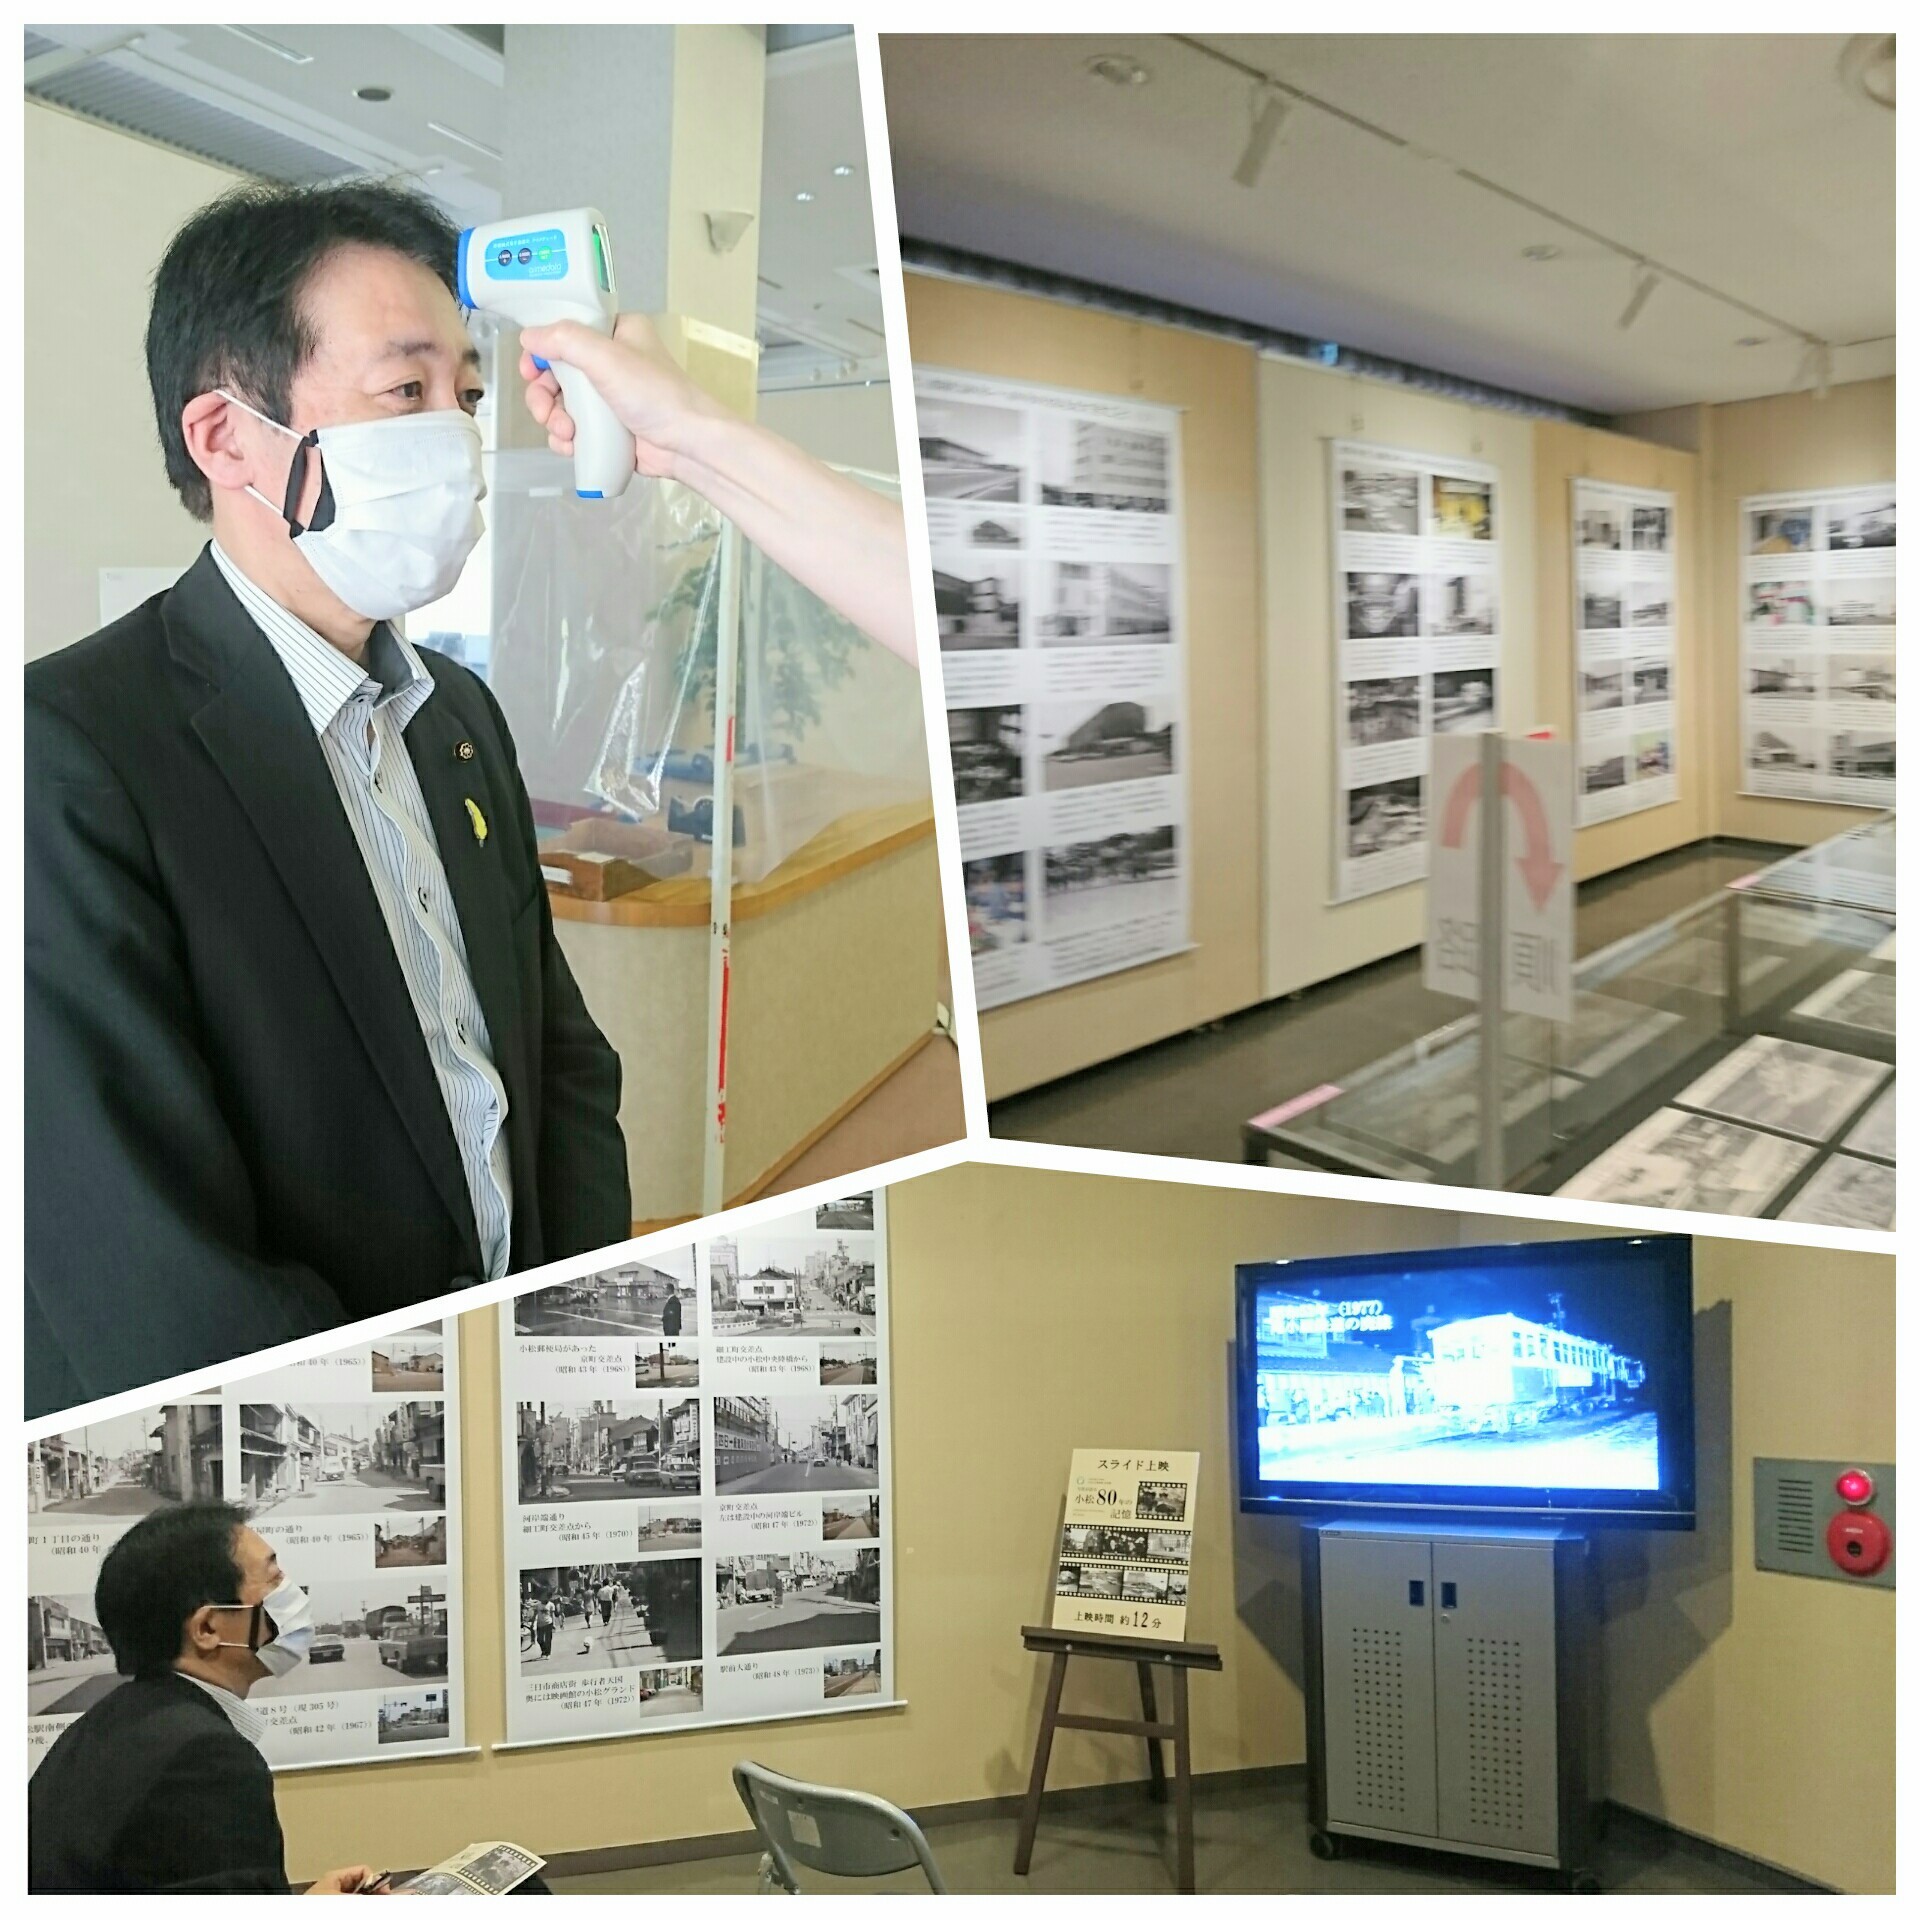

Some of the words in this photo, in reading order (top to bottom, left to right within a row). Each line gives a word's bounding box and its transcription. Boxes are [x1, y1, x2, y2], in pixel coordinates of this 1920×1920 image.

[519, 1344, 597, 1353] 小松郵便局があった
[1097, 1459, 1170, 1472] スライド上映
[1110, 1508, 1132, 1519] 記憶
[1074, 1610, 1115, 1625] 上映時間
[1119, 1611, 1162, 1628] 約12分
[720, 1662, 758, 1673] 駅前大通り
[525, 1684, 635, 1703] 奥には映画館の小松グランド
